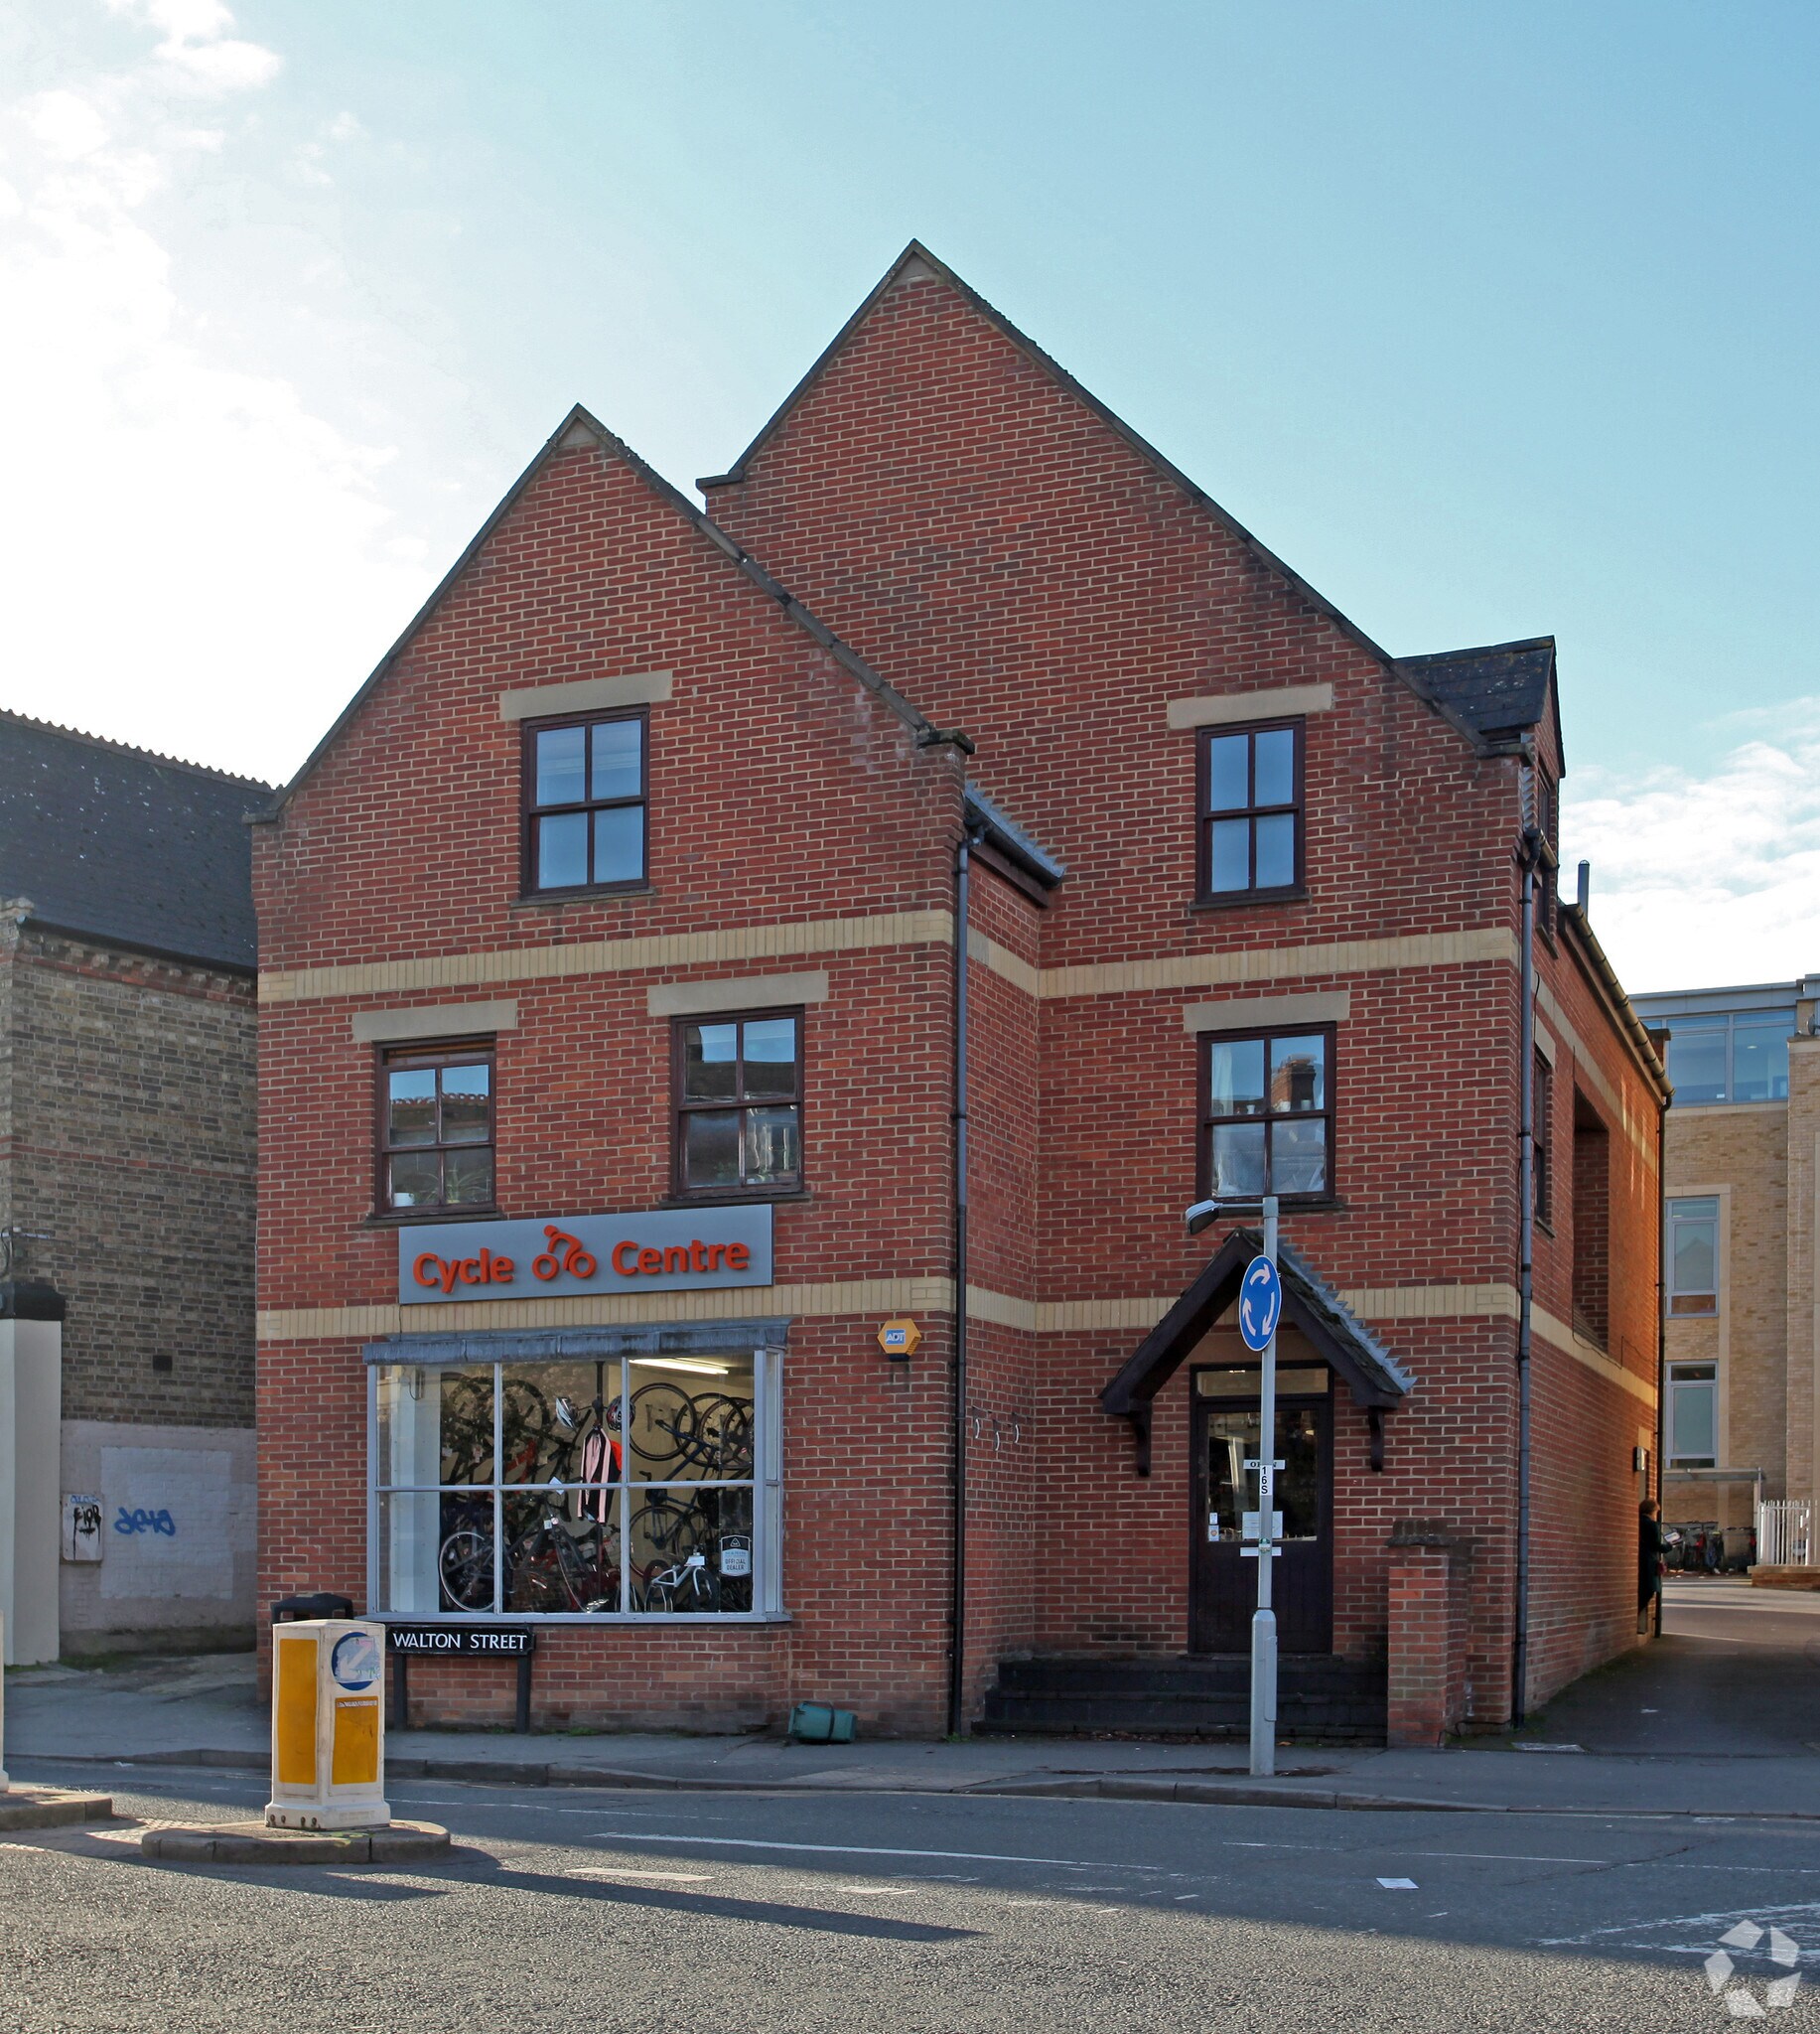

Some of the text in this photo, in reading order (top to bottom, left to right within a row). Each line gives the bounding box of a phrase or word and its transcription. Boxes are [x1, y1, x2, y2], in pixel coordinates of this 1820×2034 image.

[413, 1239, 751, 1294] Cycle Centre
[886, 1332, 905, 1342] ADT
[393, 1633, 527, 1650] WALTON STREET
